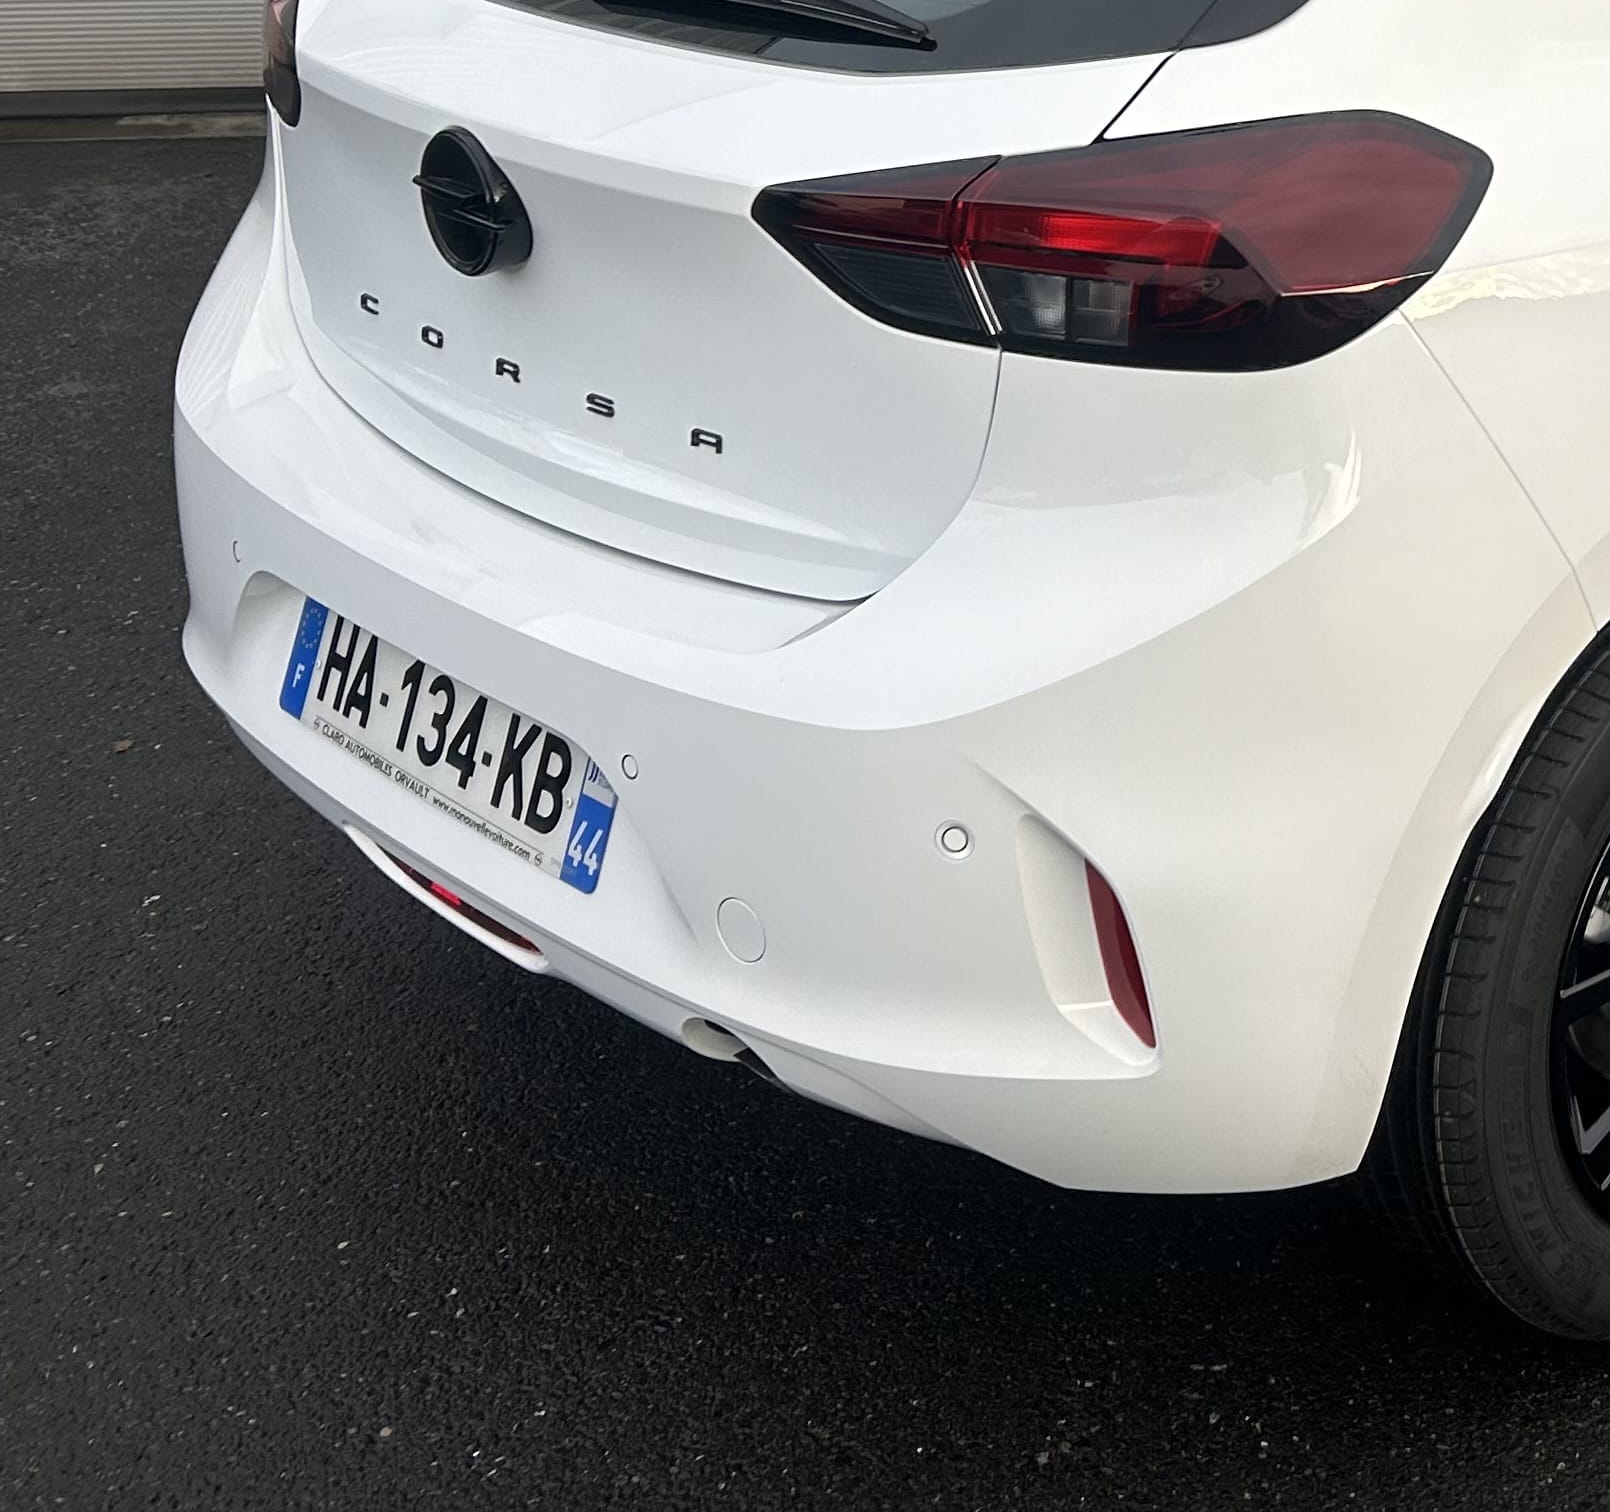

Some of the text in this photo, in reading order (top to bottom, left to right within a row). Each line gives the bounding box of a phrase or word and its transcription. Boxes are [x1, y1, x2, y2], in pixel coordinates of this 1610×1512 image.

[359, 291, 724, 455] CORSA
[291, 662, 306, 689] F
[316, 614, 573, 835] HA-134-KB
[345, 739, 393, 777] AUTOMOBILES
[394, 770, 430, 799] ORVAULT
[567, 819, 604, 877] 44
